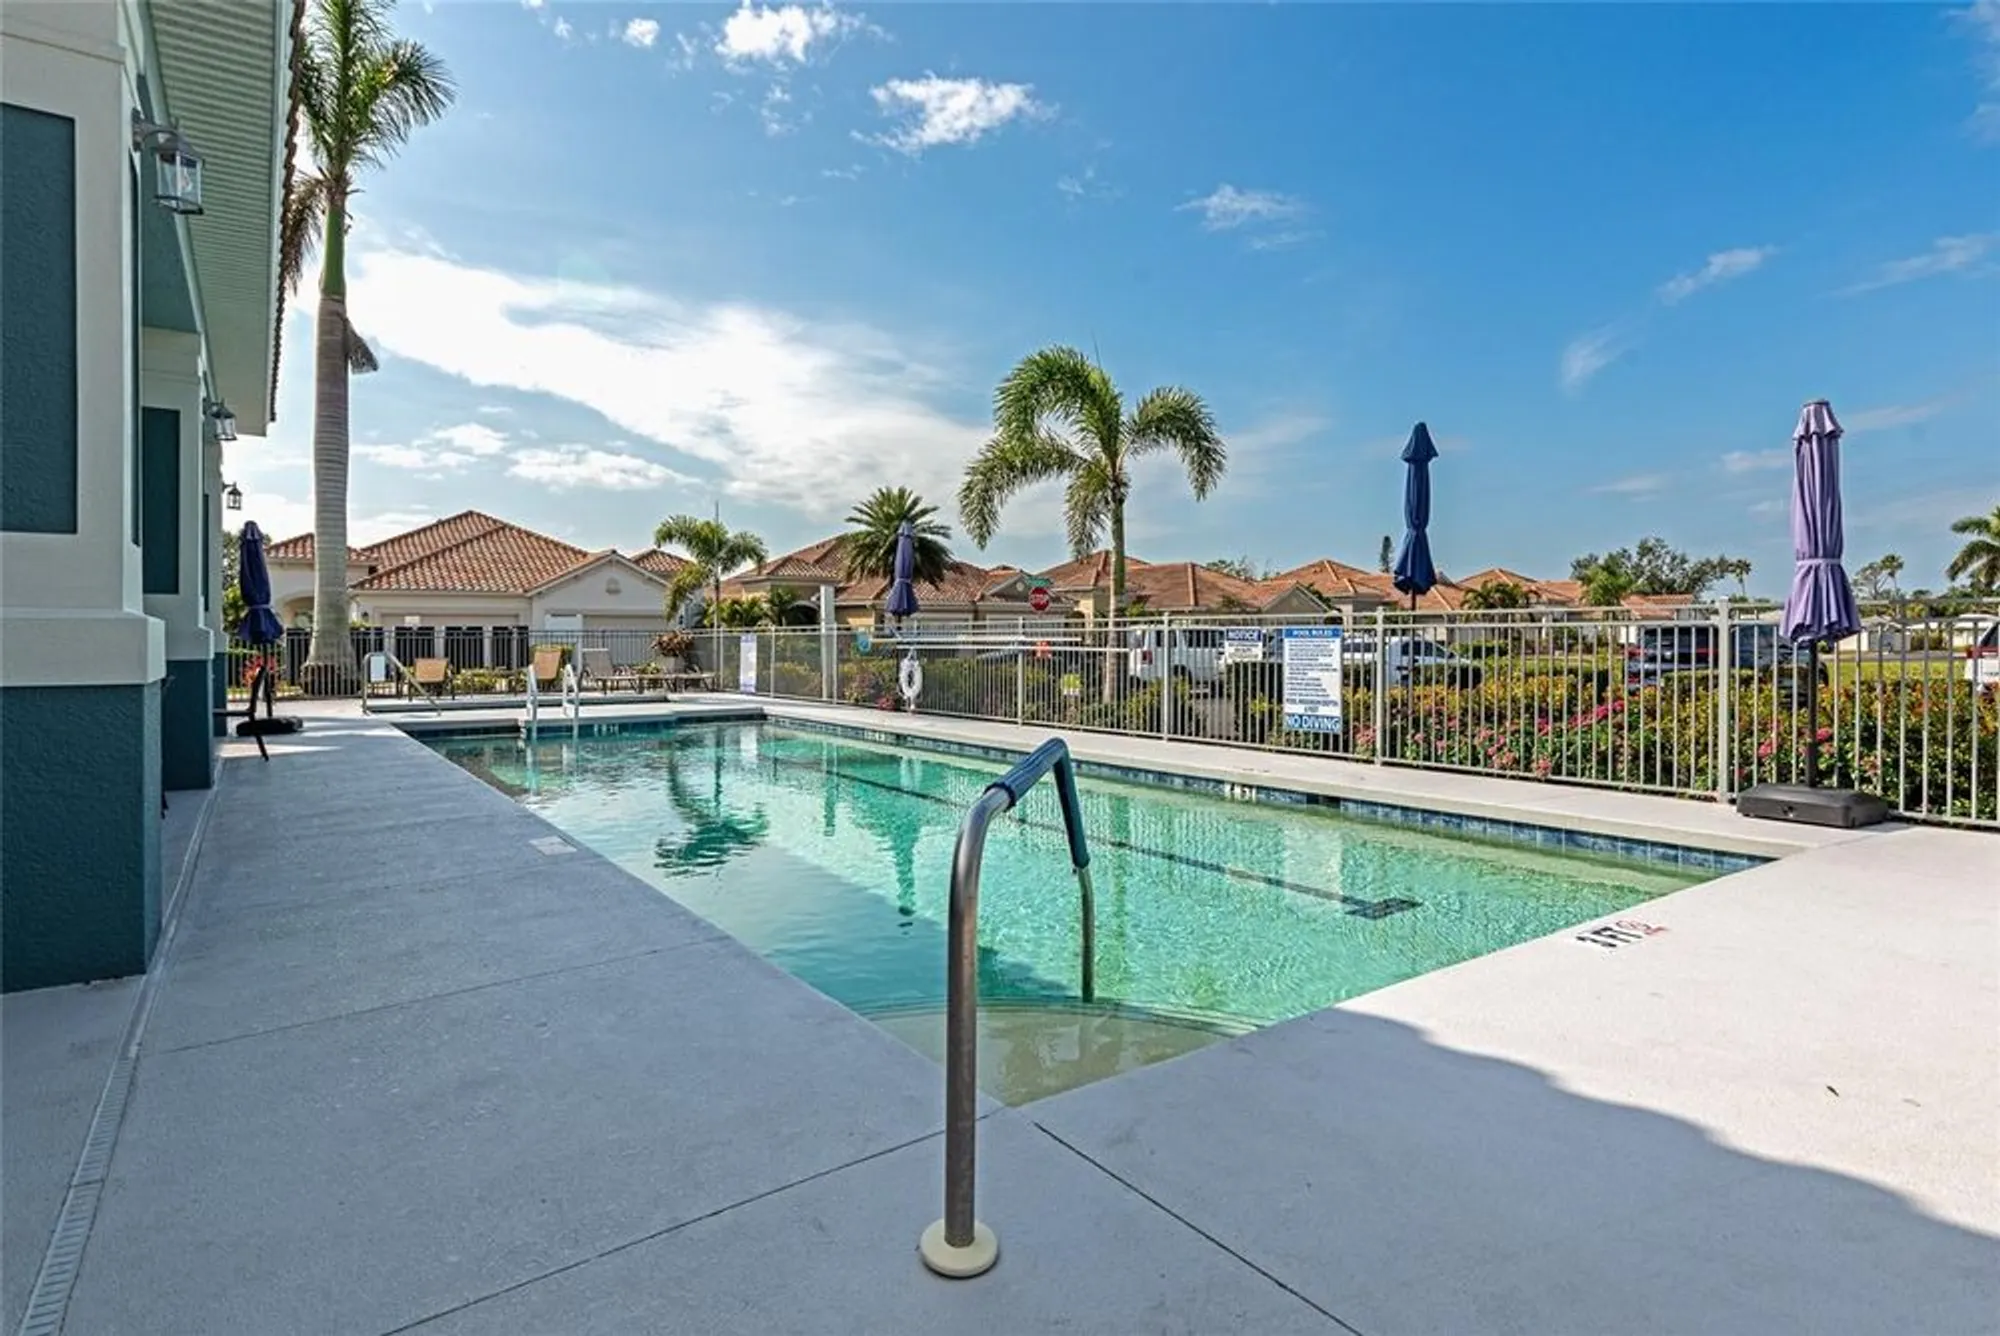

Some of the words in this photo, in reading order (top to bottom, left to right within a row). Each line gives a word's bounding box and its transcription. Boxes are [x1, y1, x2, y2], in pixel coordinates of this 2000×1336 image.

[1228, 629, 1259, 641] NOTICE
[1286, 714, 1301, 729] NO
[1302, 715, 1340, 731] DIVING
